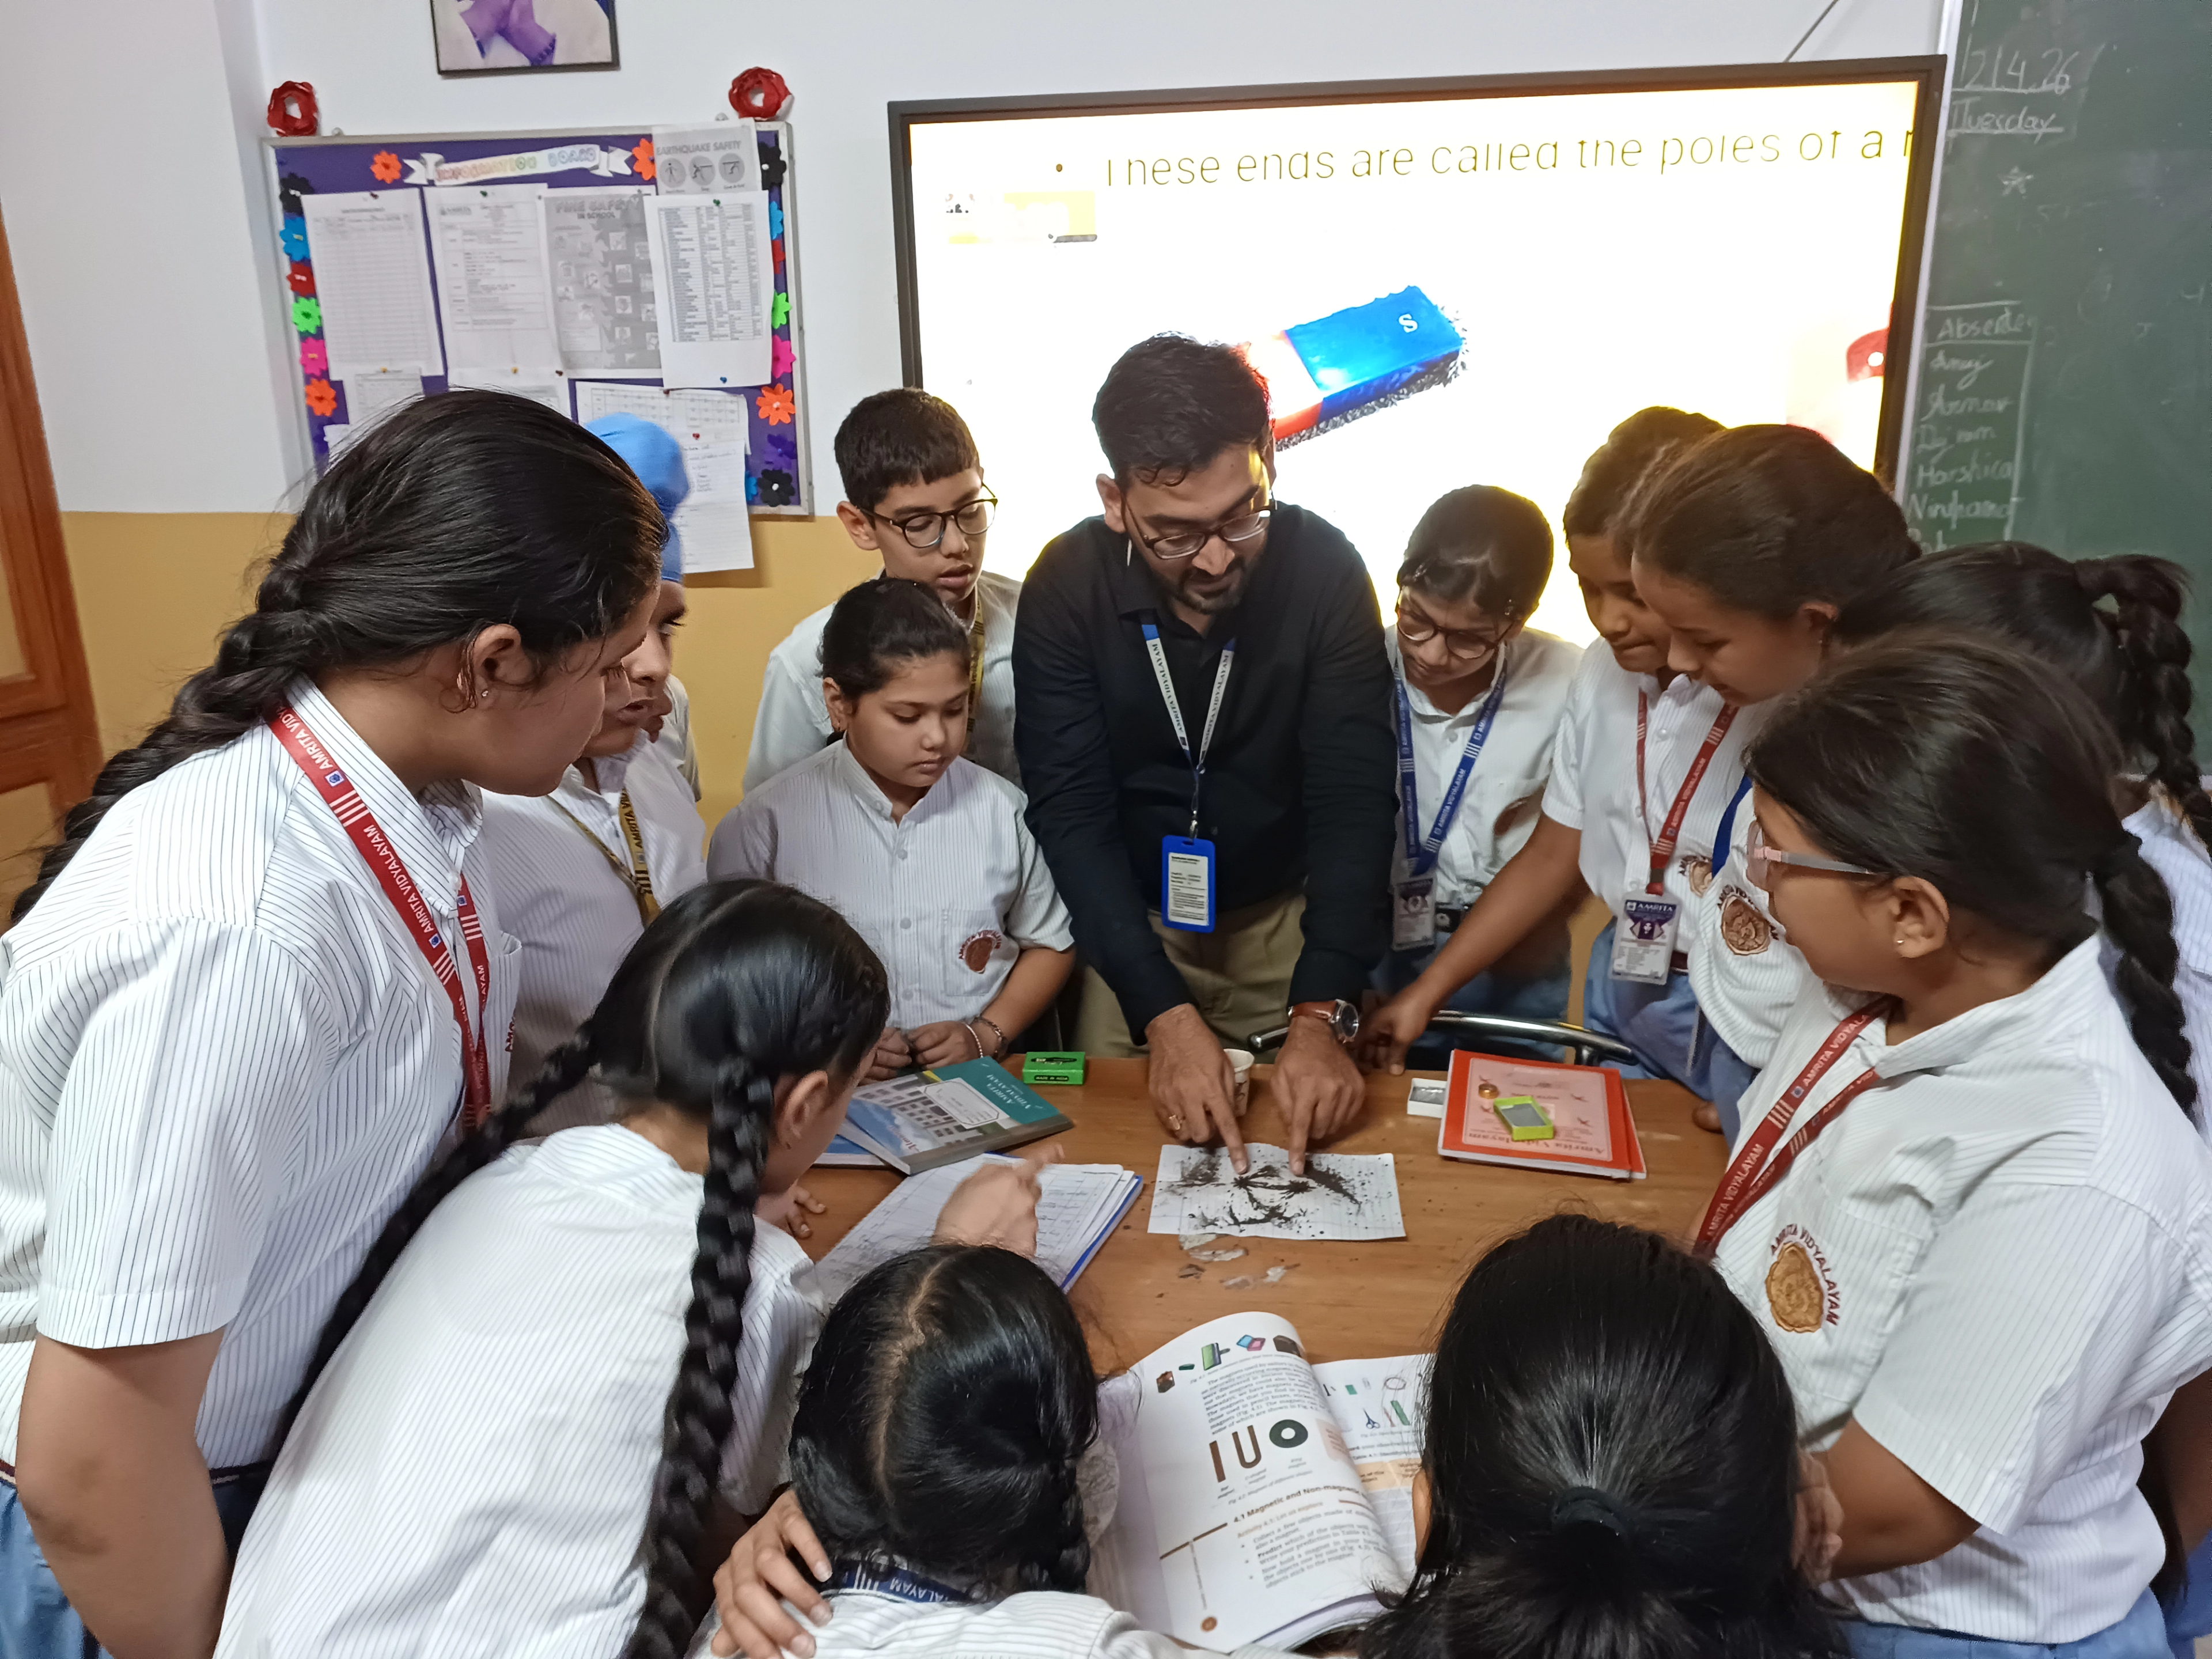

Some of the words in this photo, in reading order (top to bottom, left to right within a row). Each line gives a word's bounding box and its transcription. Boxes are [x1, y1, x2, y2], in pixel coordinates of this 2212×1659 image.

[656, 142, 711, 156] EARTHQUAKE
[713, 140, 742, 151] SAFETY
[1236, 150, 1335, 182] ends
[1350, 146, 1415, 177] are
[1430, 139, 1558, 176] called
[1577, 138, 1643, 168] the
[1658, 131, 1782, 176] poles
[1797, 128, 1843, 162] of
[1859, 127, 1885, 159] a
[1397, 312, 1420, 335] S
[298, 732, 333, 770] AMRITA
[363, 824, 415, 895] VIDYALAYAM
[409, 892, 435, 934] AMRITA
[1803, 1049, 1832, 1086] AMRITA
[986, 1083, 1016, 1104] AMRITA
[987, 1074, 1032, 1109] VIDYALAYAM
[1707, 1201, 1732, 1237] AMRITA
[1724, 1143, 1765, 1202] VIDYALAYAM
[1798, 1226, 1842, 1326] VIDYALAYAM
[1233, 1513, 1245, 1523] 4.1
[1247, 1497, 1284, 1517] Magnetic
[1286, 1491, 1301, 1501] and
[1258, 1544, 1282, 1557] Predict
